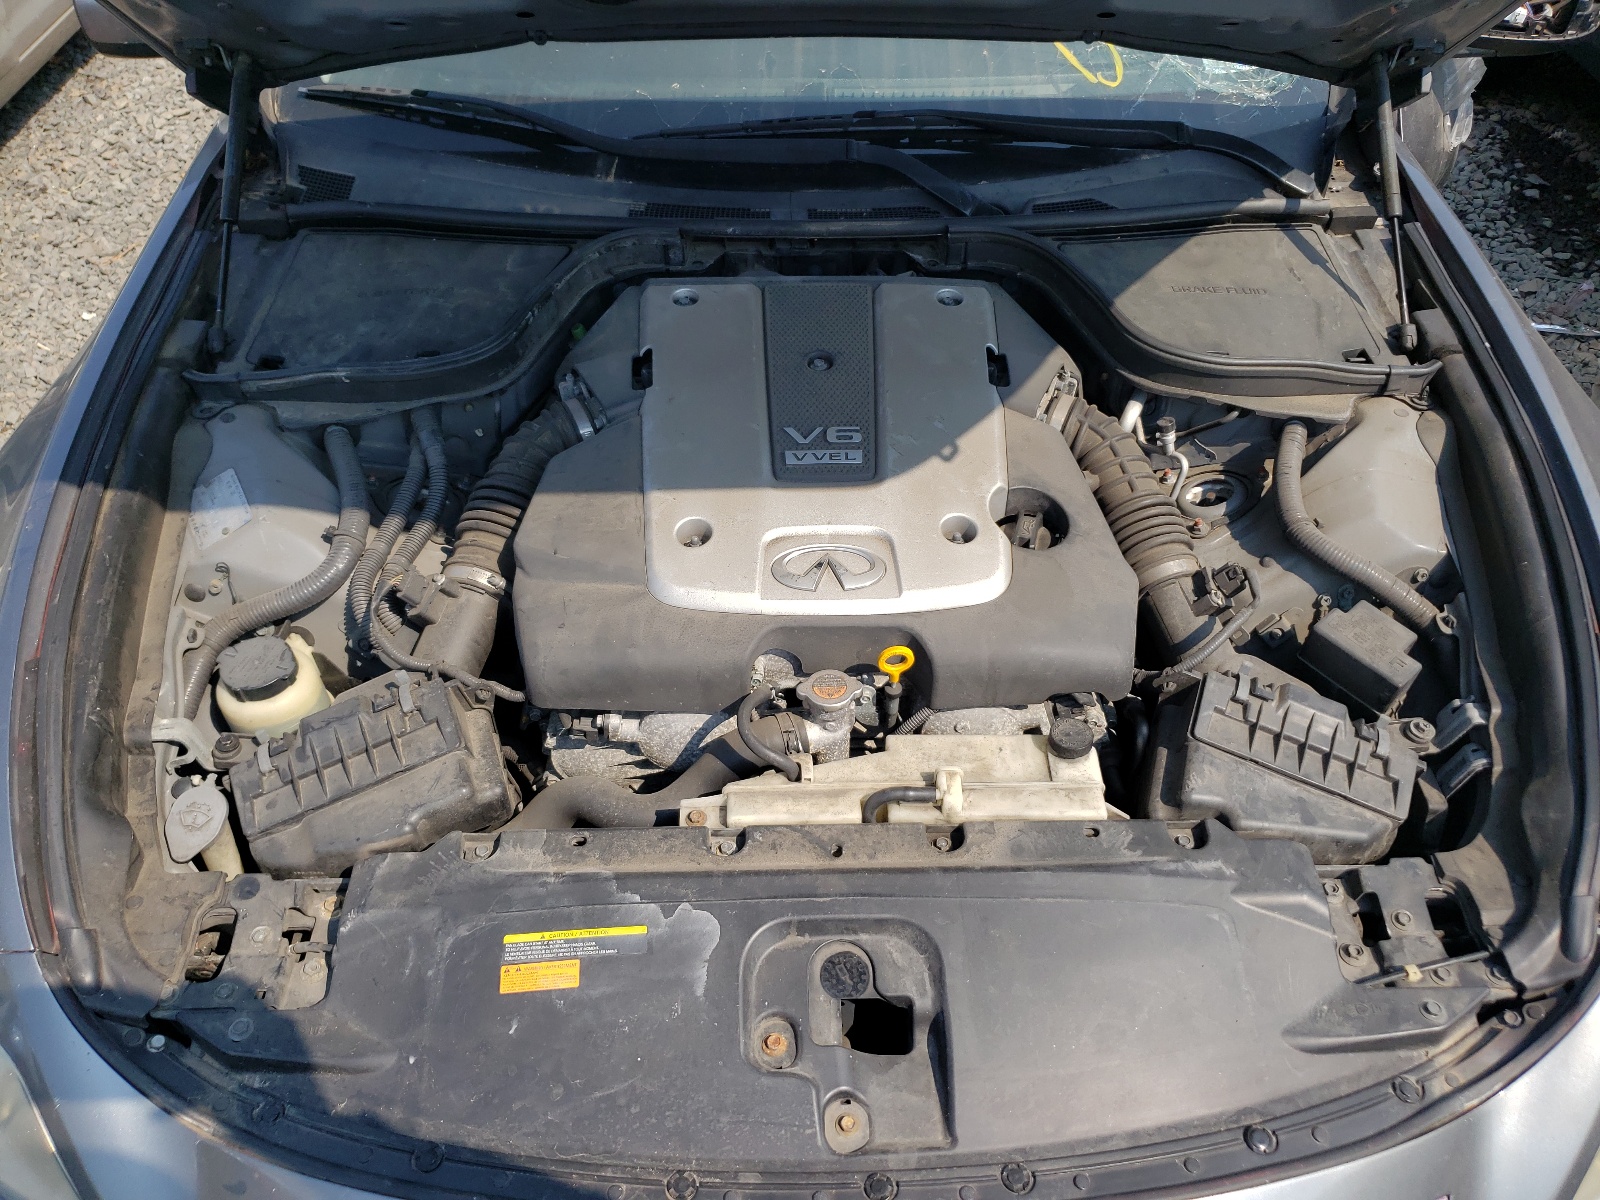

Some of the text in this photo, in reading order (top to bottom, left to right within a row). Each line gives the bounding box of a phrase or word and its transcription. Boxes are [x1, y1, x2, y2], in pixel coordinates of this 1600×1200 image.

[1170, 285, 1268, 295] BRAKE FLUID
[783, 426, 863, 444] V6
[791, 451, 857, 462] VVEL
[548, 931, 574, 939] CAUTION
[578, 929, 609, 937] ATTENTION
